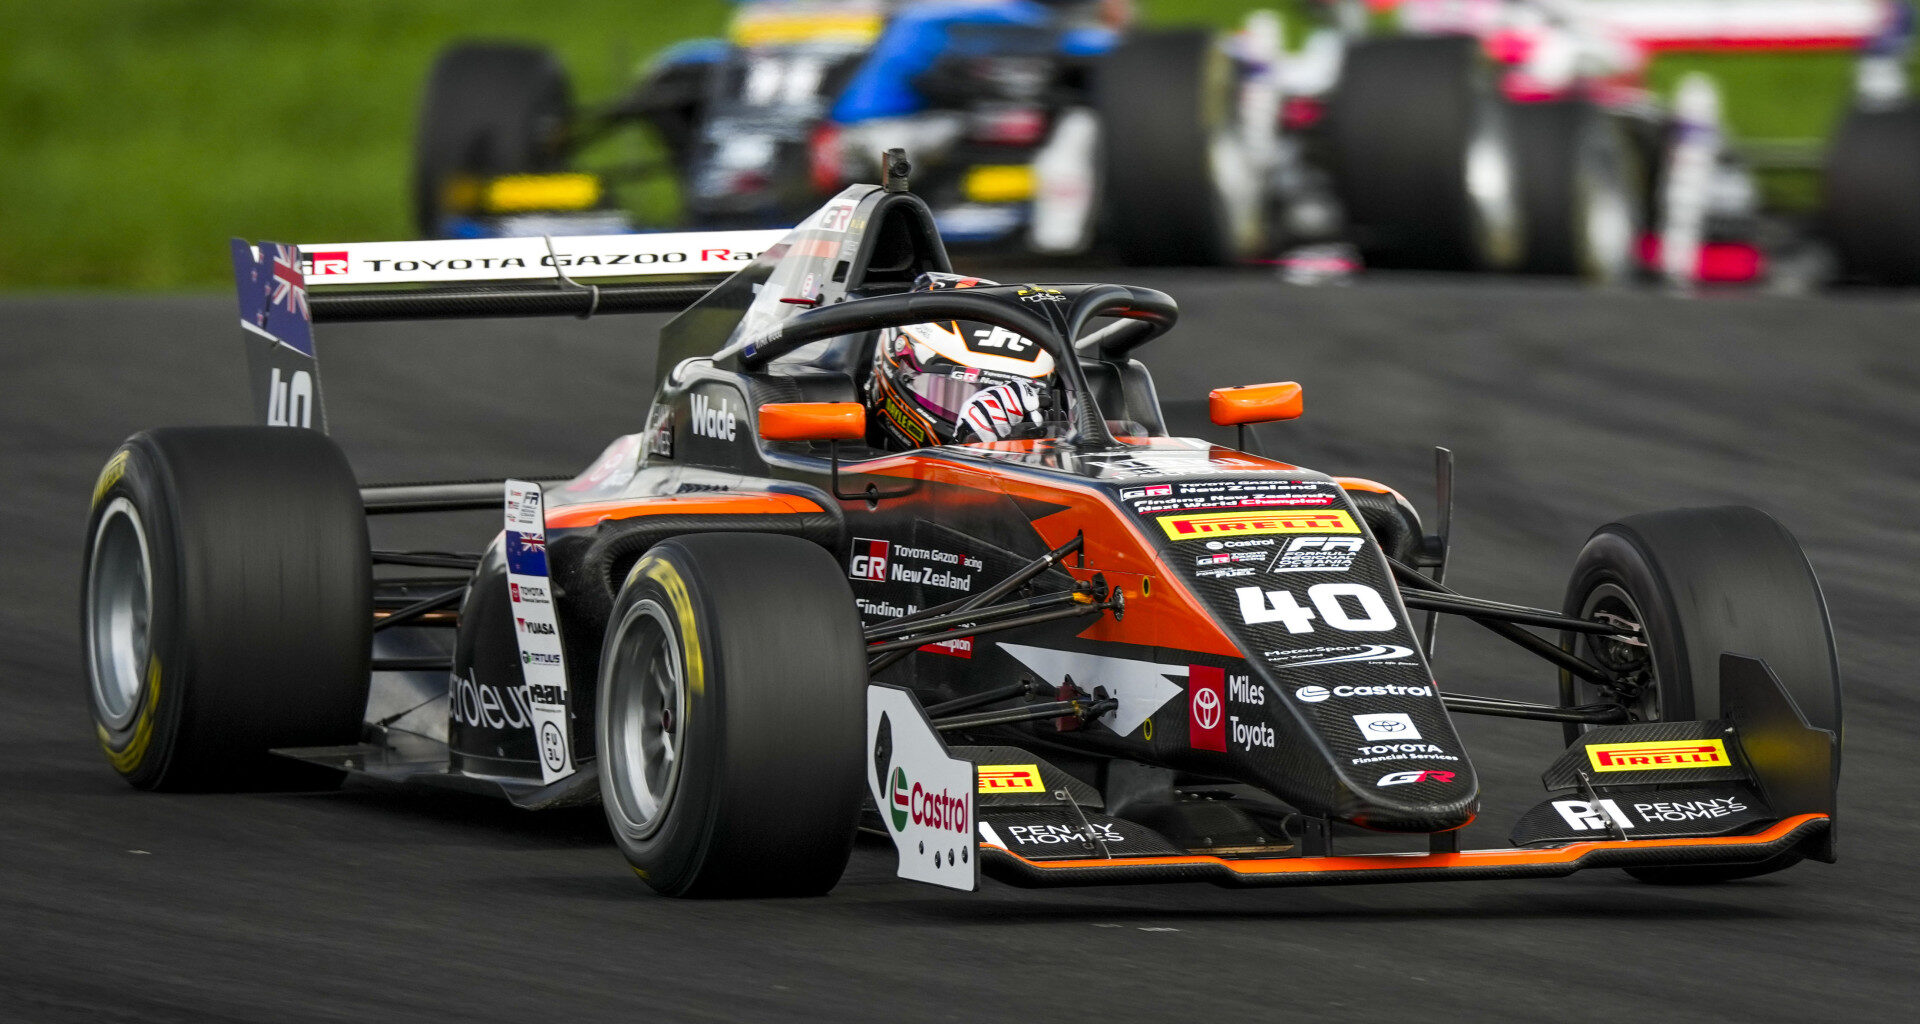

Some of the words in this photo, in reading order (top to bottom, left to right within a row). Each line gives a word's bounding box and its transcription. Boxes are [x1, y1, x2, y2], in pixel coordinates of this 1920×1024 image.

[363, 258, 525, 272] TOYOTA
[541, 252, 687, 266] GAZOO
[267, 368, 312, 428] 40
[690, 393, 736, 442] Wade
[1123, 487, 1171, 500] GR
[1134, 498, 1205, 507] Finding
[1138, 503, 1180, 513] Next
[1171, 514, 1344, 534] PIRELLI
[1224, 538, 1275, 548] Castrol
[851, 555, 886, 579] GR
[894, 544, 930, 560] TOYOTA
[931, 550, 959, 564] GAZOO
[959, 554, 983, 572] Racing
[1198, 556, 1231, 566] GR
[891, 563, 922, 583] New
[922, 567, 971, 592] Zealand
[1235, 582, 1397, 634] 40
[525, 621, 556, 635] YUASA
[1229, 675, 1265, 705] Miles
[1333, 684, 1433, 697] Castrol
[1229, 715, 1275, 751] Toyota
[1352, 753, 1408, 765] Financial
[1409, 753, 1459, 761] Services
[1357, 743, 1444, 756] TOYOTA
[1596, 746, 1719, 767] PIRELLI
[1376, 770, 1456, 787] GR
[911, 781, 969, 834] Castrol
[1633, 796, 1735, 814] PENNY
[1640, 803, 1748, 822] HOMES
